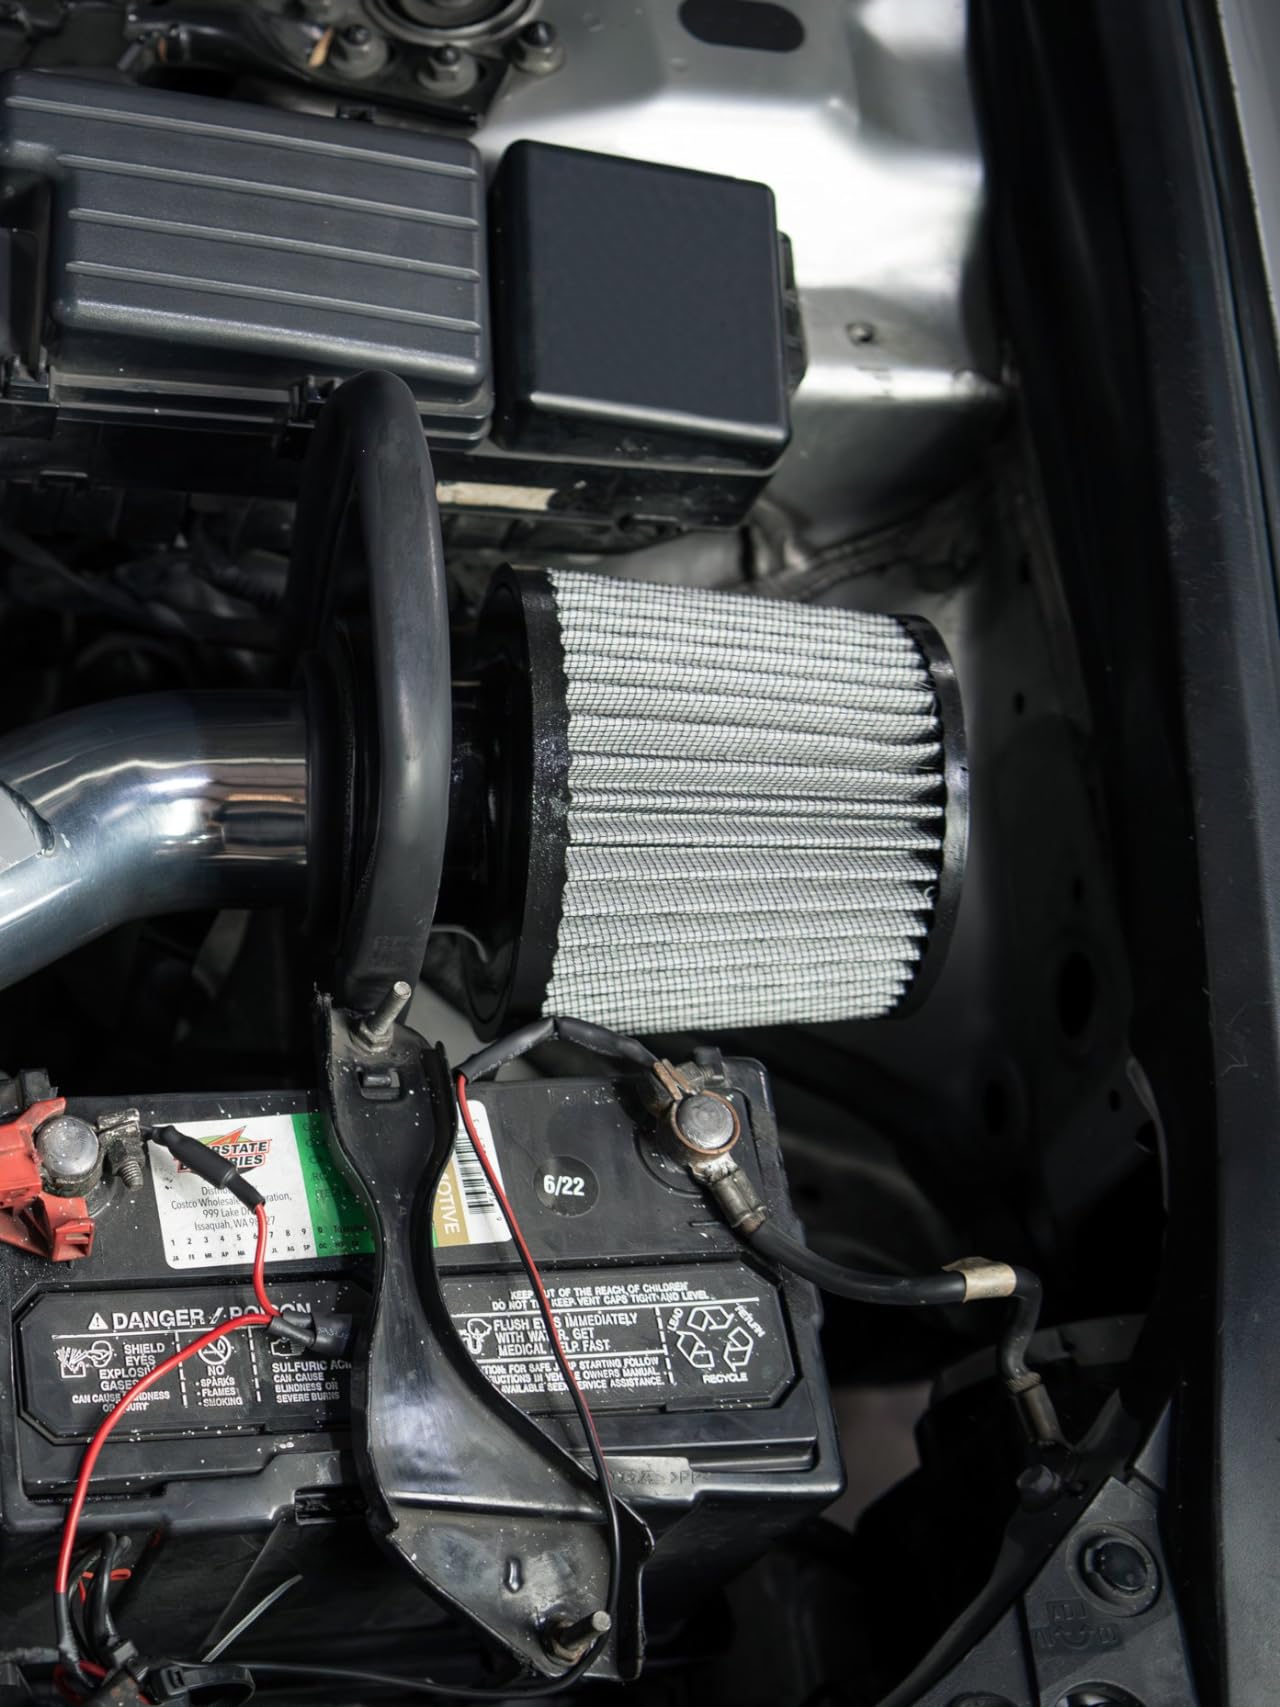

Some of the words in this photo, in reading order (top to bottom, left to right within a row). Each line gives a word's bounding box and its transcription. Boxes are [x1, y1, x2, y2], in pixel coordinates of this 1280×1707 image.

[210, 1141, 268, 1154] RSTATE
[543, 1174, 585, 1196] 6/22
[171, 1199, 197, 1210] Costco
[437, 1172, 461, 1235] OTIVE
[203, 1208, 219, 1218] 999
[220, 1206, 239, 1217] Lake
[194, 1219, 233, 1232] Issaquah,
[233, 1218, 248, 1228] WA
[187, 1237, 192, 1245] 2
[253, 1232, 258, 1240] 6
[286, 1229, 291, 1237] 8
[510, 1289, 534, 1300] KEEP
[543, 1288, 556, 1298] UT
[558, 1287, 571, 1297] OF
[573, 1286, 593, 1297] THE
[594, 1285, 625, 1296] REACH
[627, 1284, 640, 1294] OF
[492, 1301, 506, 1311] DO
[508, 1300, 527, 1311] NOT
[530, 1299, 540, 1309] TI
[577, 1296, 600, 1306] VENT
[603, 1295, 628, 1305] CAPS
[631, 1293, 657, 1303] TIGHT
[660, 1292, 679, 1302] AND
[112, 1308, 206, 1330] DANGER
[493, 1319, 530, 1331] FLUSH
[564, 1312, 638, 1329] IMMEDIATELY
[667, 1307, 684, 1332] LEAD
[734, 1304, 766, 1338] RETURN
[495, 1331, 525, 1344] WITH
[572, 1327, 595, 1340] GET
[124, 1342, 165, 1355] SHIELD
[498, 1343, 547, 1357] MEDICAL
[125, 1355, 156, 1367] EYES
[271, 1360, 327, 1373] SULFURIC
[509, 1363, 527, 1373] FOR
[528, 1362, 551, 1373] SAFE
[579, 1359, 622, 1370] STARTING
[624, 1356, 659, 1368] FOLLOW
[207, 1365, 225, 1377] NO
[273, 1373, 292, 1383] CAN
[295, 1372, 325, 1382] CAUSE
[534, 1373, 544, 1382] IN
[583, 1369, 620, 1380] OWNERS
[200, 1376, 235, 1387] SPARKS
[702, 1372, 748, 1384] RECYCLE
[275, 1383, 322, 1393] BLINDNESS
[325, 1381, 339, 1390] OR
[501, 1383, 545, 1394] AVAILABLE
[577, 1379, 607, 1390] ERVICE
[610, 1376, 665, 1388] ASSISTANCE.
[202, 1387, 236, 1397] FLAMES
[276, 1392, 310, 1403] SEVERE
[311, 1391, 340, 1401] BURNS
[72, 1394, 91, 1404] CAN
[203, 1396, 243, 1407] SMOKING
